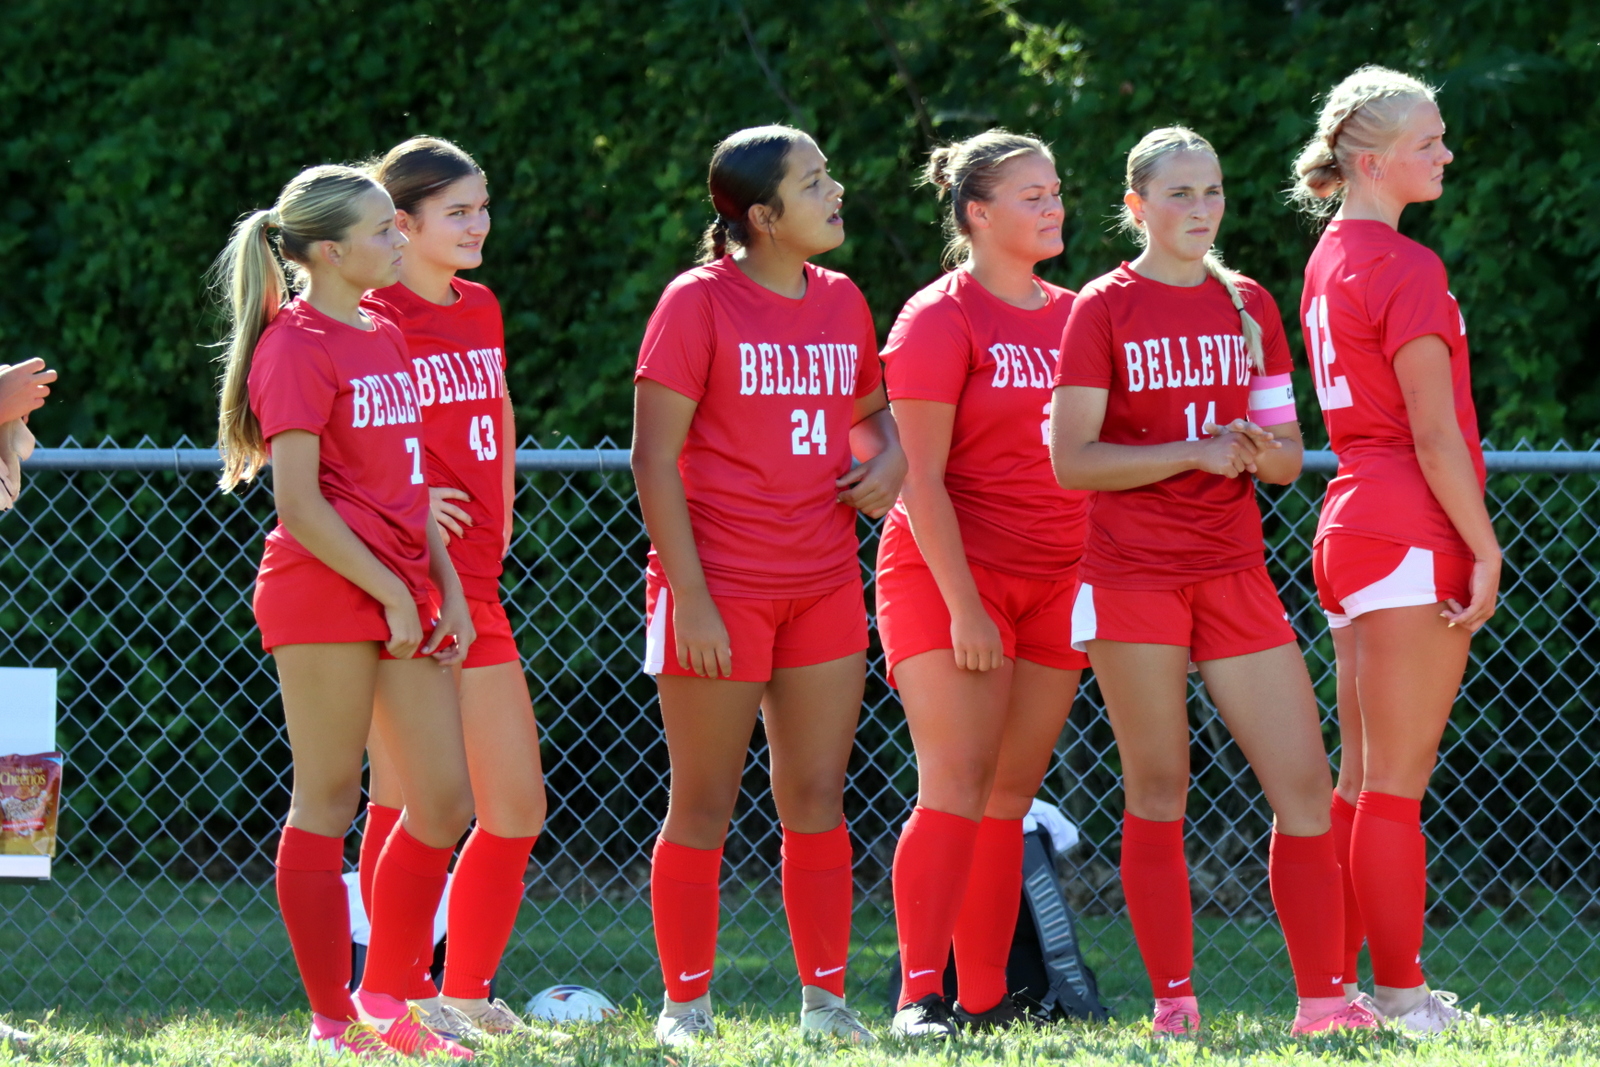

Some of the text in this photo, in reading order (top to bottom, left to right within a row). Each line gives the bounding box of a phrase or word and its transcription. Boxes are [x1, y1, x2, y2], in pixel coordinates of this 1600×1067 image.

[739, 343, 857, 395] BELLEVUE
[1306, 295, 1353, 410] 12
[470, 415, 497, 461] 43
[791, 409, 827, 455] 24
[405, 437, 424, 485] 7
